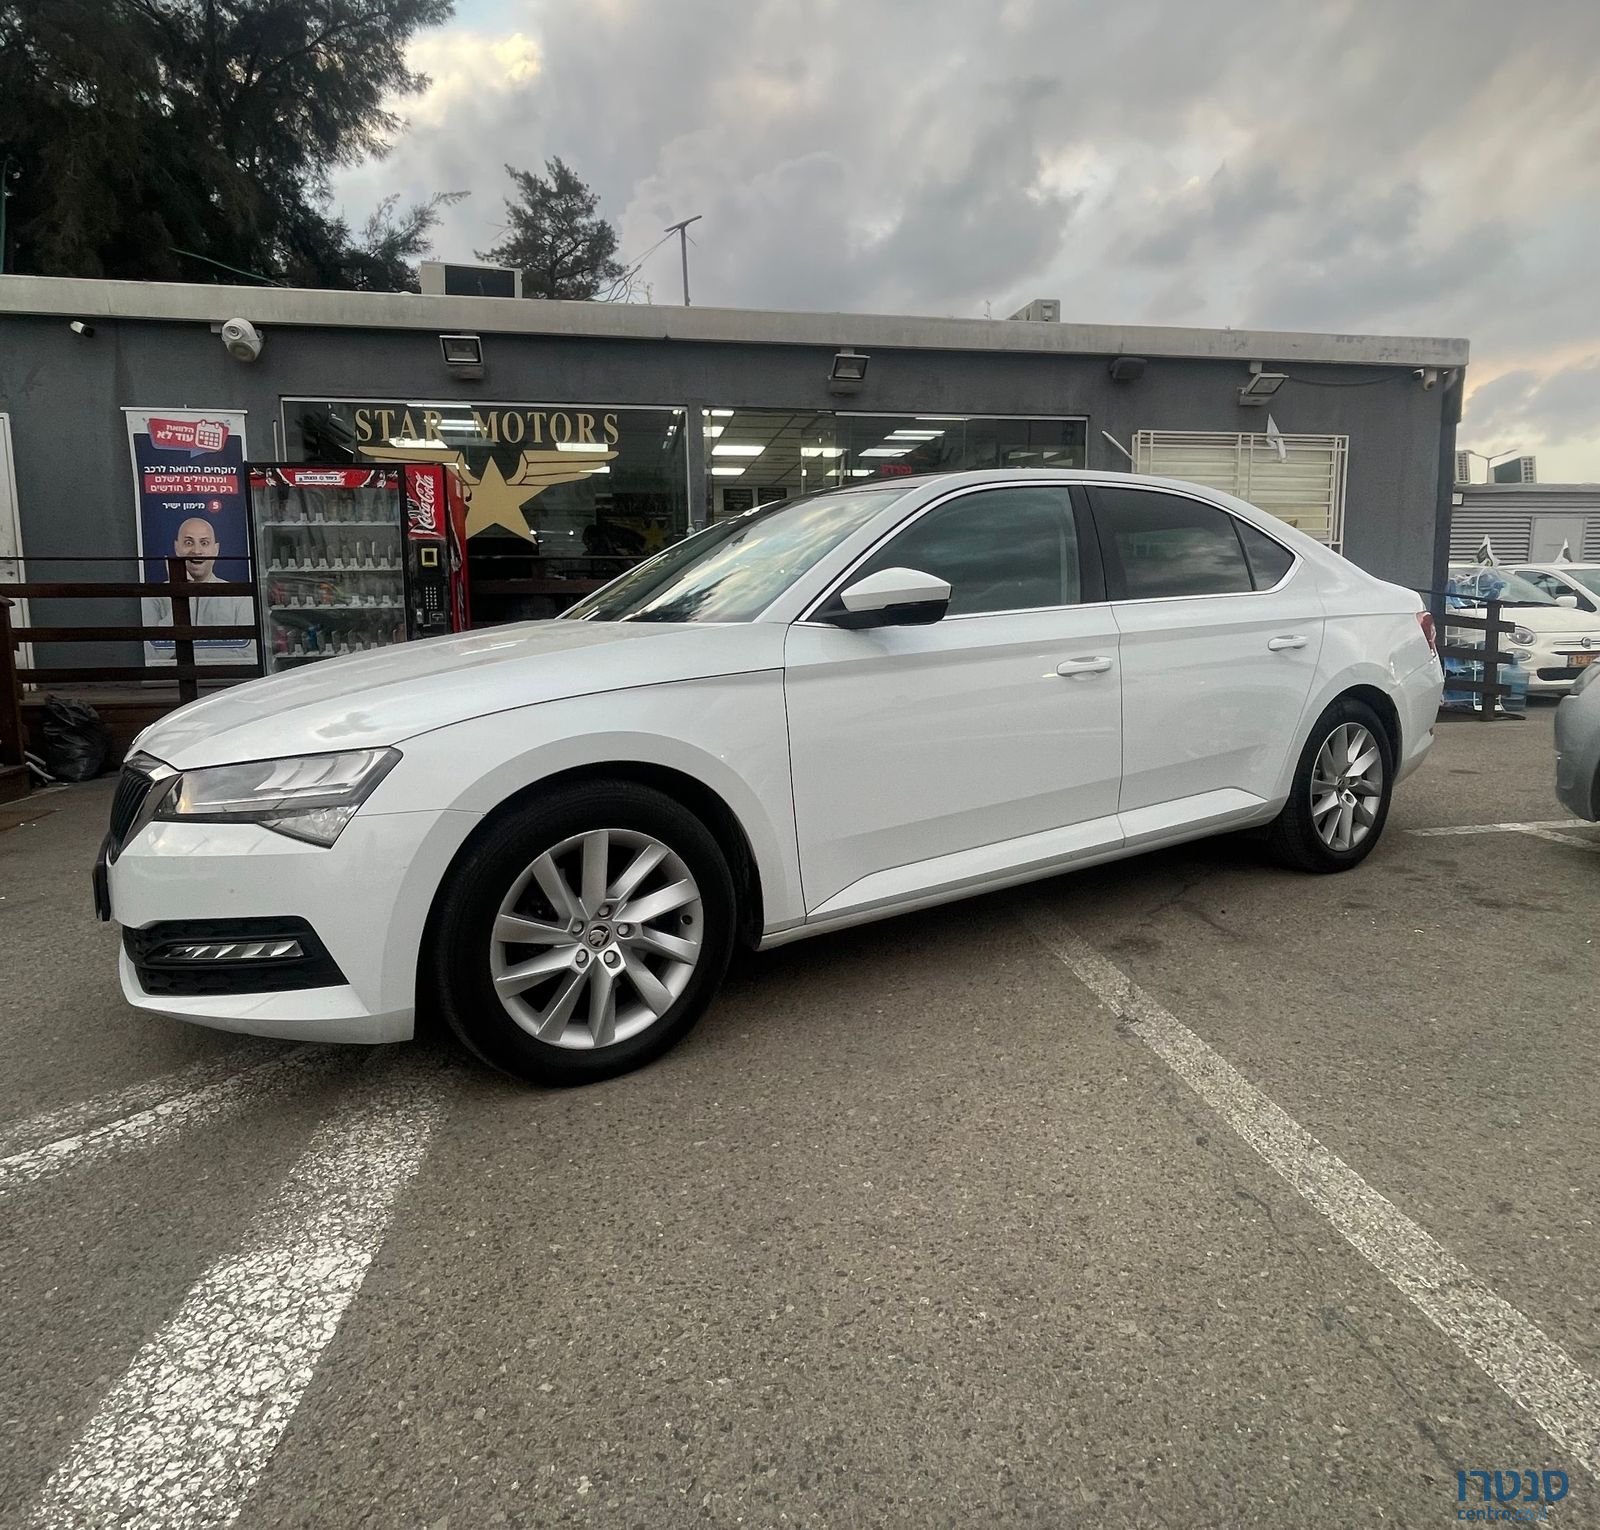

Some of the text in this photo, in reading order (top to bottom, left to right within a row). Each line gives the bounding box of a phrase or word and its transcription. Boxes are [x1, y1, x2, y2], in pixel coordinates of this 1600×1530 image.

[355, 408, 620, 445] STAR MOTORS
[156, 430, 194, 442] עוד לא
[144, 465, 237, 474] לוקחים הלוואה לרכב
[154, 475, 227, 483] ומתחילים לשלם
[150, 484, 184, 492] חודשים
[220, 485, 233, 494] רק
